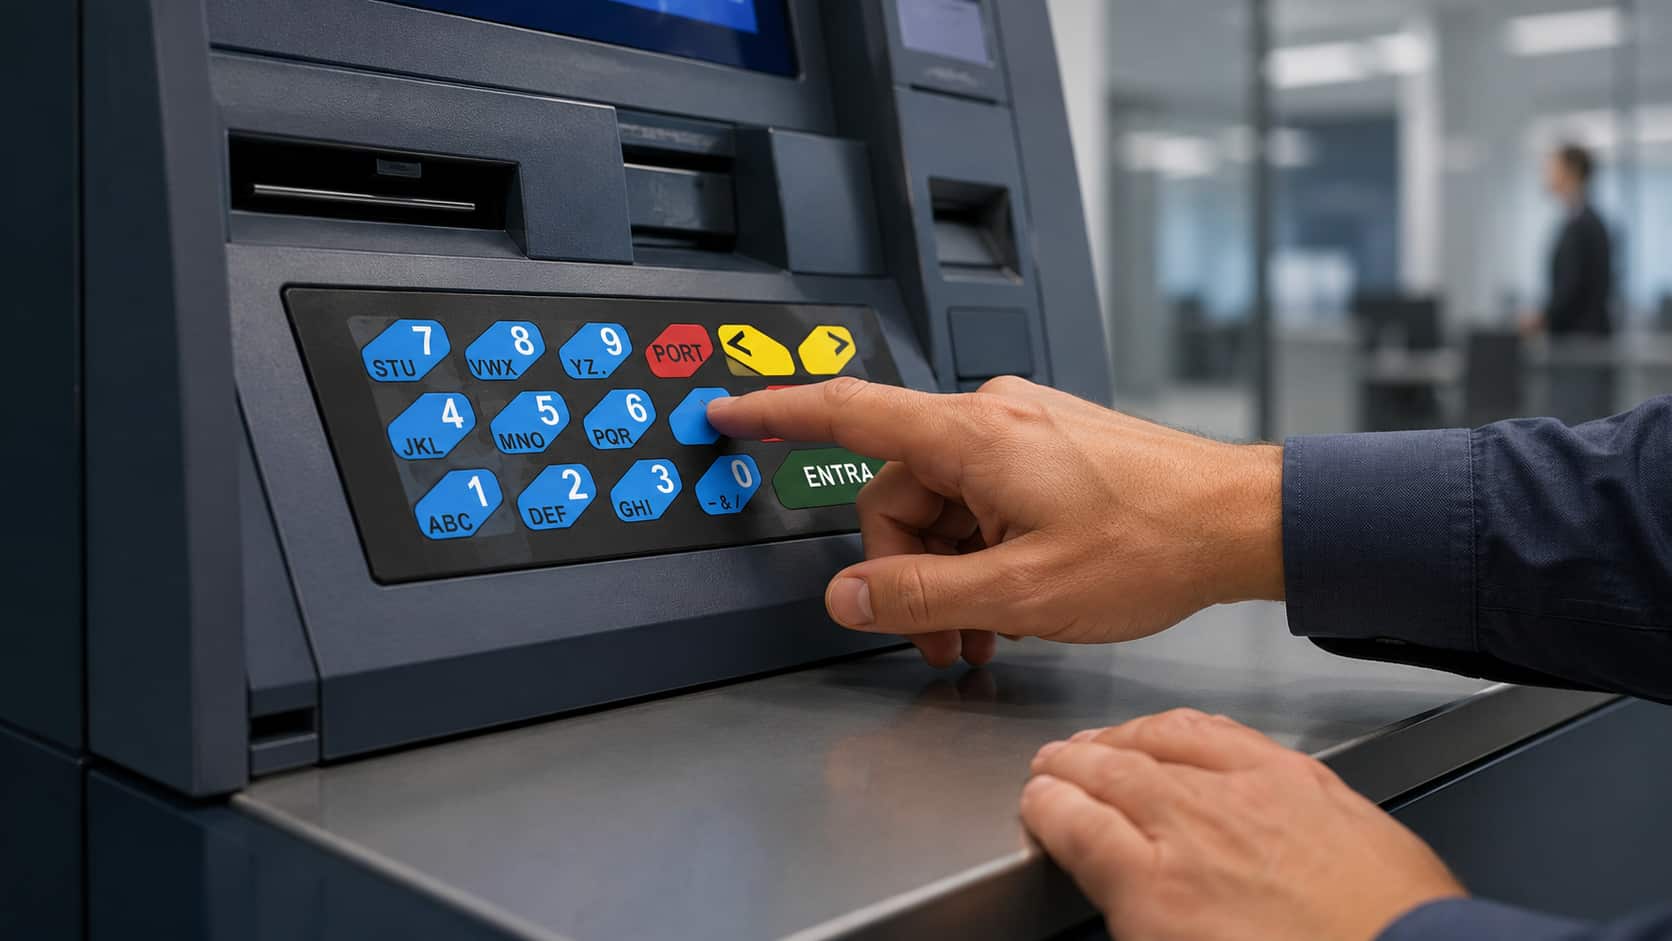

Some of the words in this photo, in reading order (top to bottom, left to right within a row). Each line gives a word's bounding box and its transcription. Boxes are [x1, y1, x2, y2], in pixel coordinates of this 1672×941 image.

[412, 325, 432, 356] 7
[510, 325, 535, 356] 8
[600, 327, 623, 356] 9
[652, 343, 704, 363] PORT
[373, 359, 417, 378] STU
[468, 359, 518, 377] VWX
[441, 397, 465, 429] 4
[535, 395, 560, 426] 5
[625, 393, 648, 423] 6
[403, 436, 444, 456] JKL
[498, 431, 546, 451] MNO
[592, 427, 633, 446] PQR
[561, 468, 589, 501] 2
[651, 464, 675, 494] 3
[730, 459, 753, 488] 0
[467, 475, 489, 507] 1
[527, 505, 567, 526] DEF
[618, 499, 653, 518] GHI
[428, 512, 473, 535] ABC
